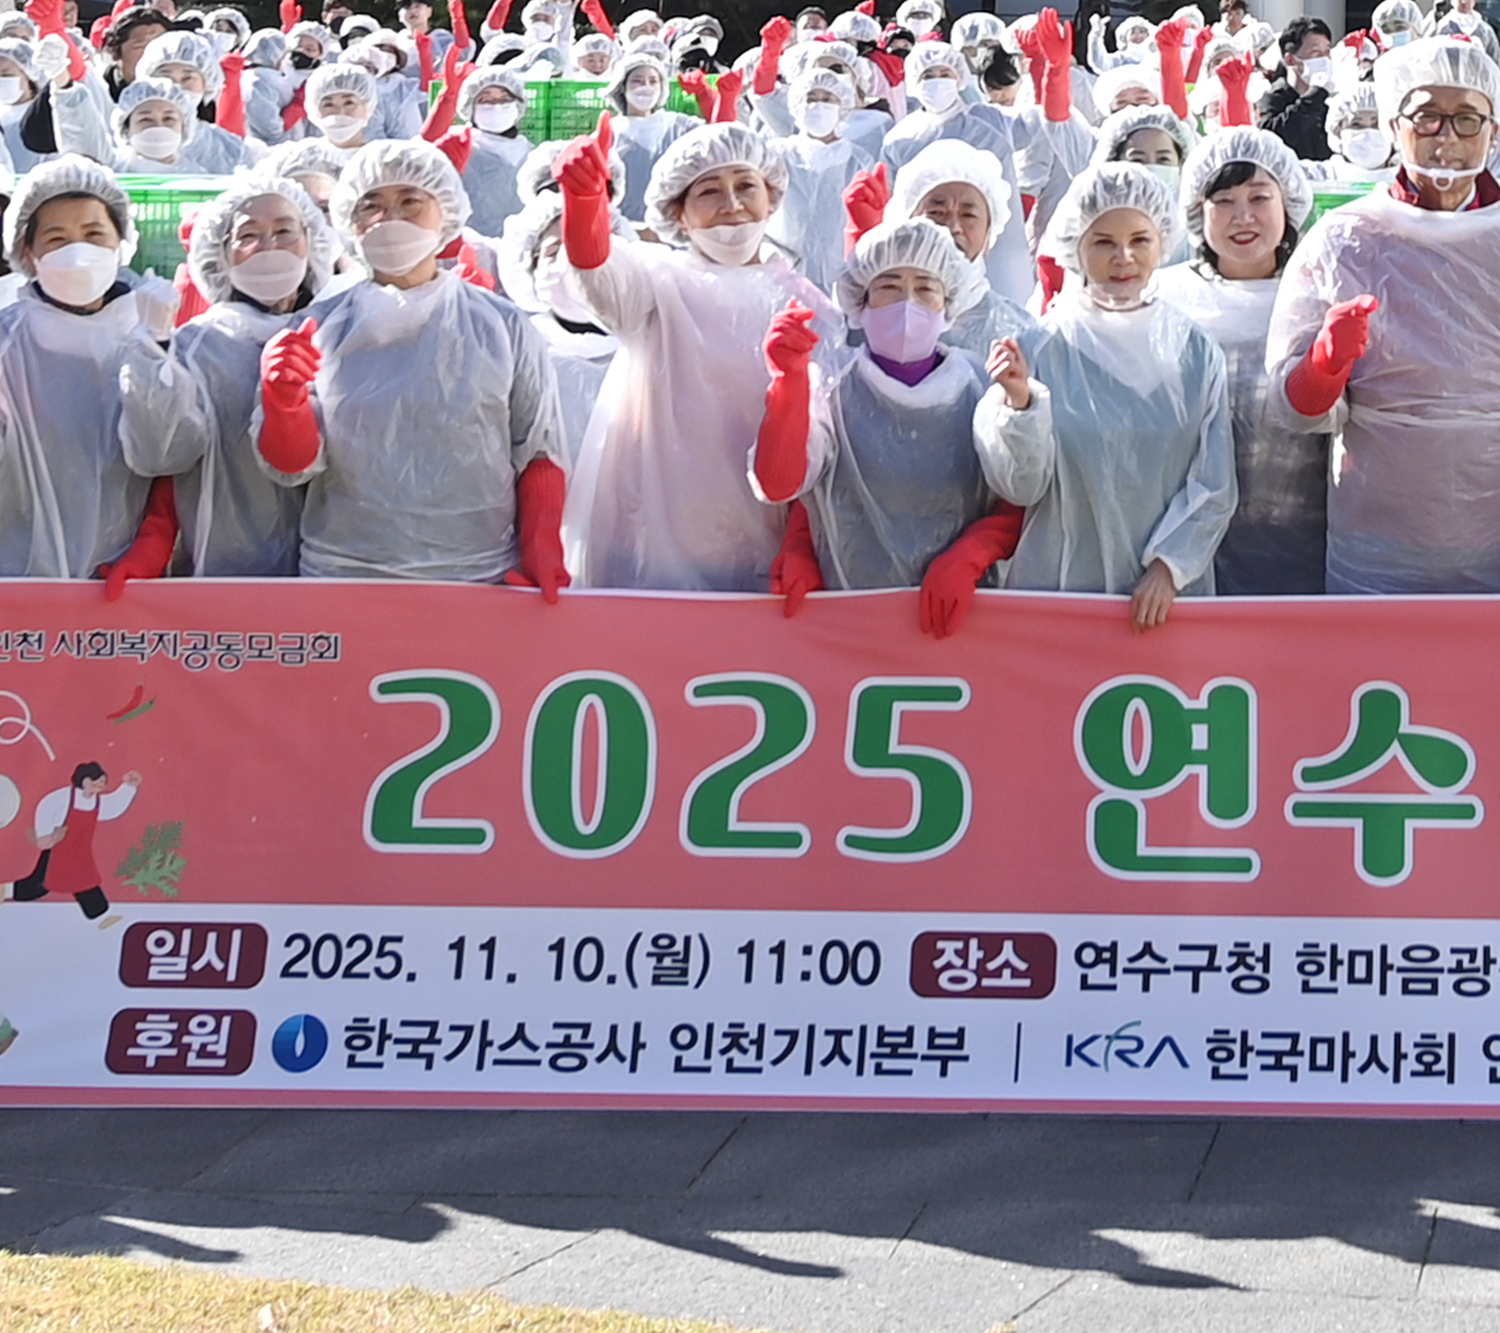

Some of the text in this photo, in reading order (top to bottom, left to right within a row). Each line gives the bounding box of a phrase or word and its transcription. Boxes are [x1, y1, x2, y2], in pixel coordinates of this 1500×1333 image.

[53, 630, 342, 671] 사회복지공동모금회
[362, 670, 971, 861] 2025
[144, 928, 881, 990] 일시 2025. 11. 10.(월) 11:00
[930, 935, 1033, 994] 장소
[1074, 941, 1271, 995] 연수구청
[126, 1013, 969, 1078] 후원 한국가스공사 인천기지본부
[1063, 1019, 1190, 1075] KRA
[1206, 1029, 1456, 1084] 한국마사회
